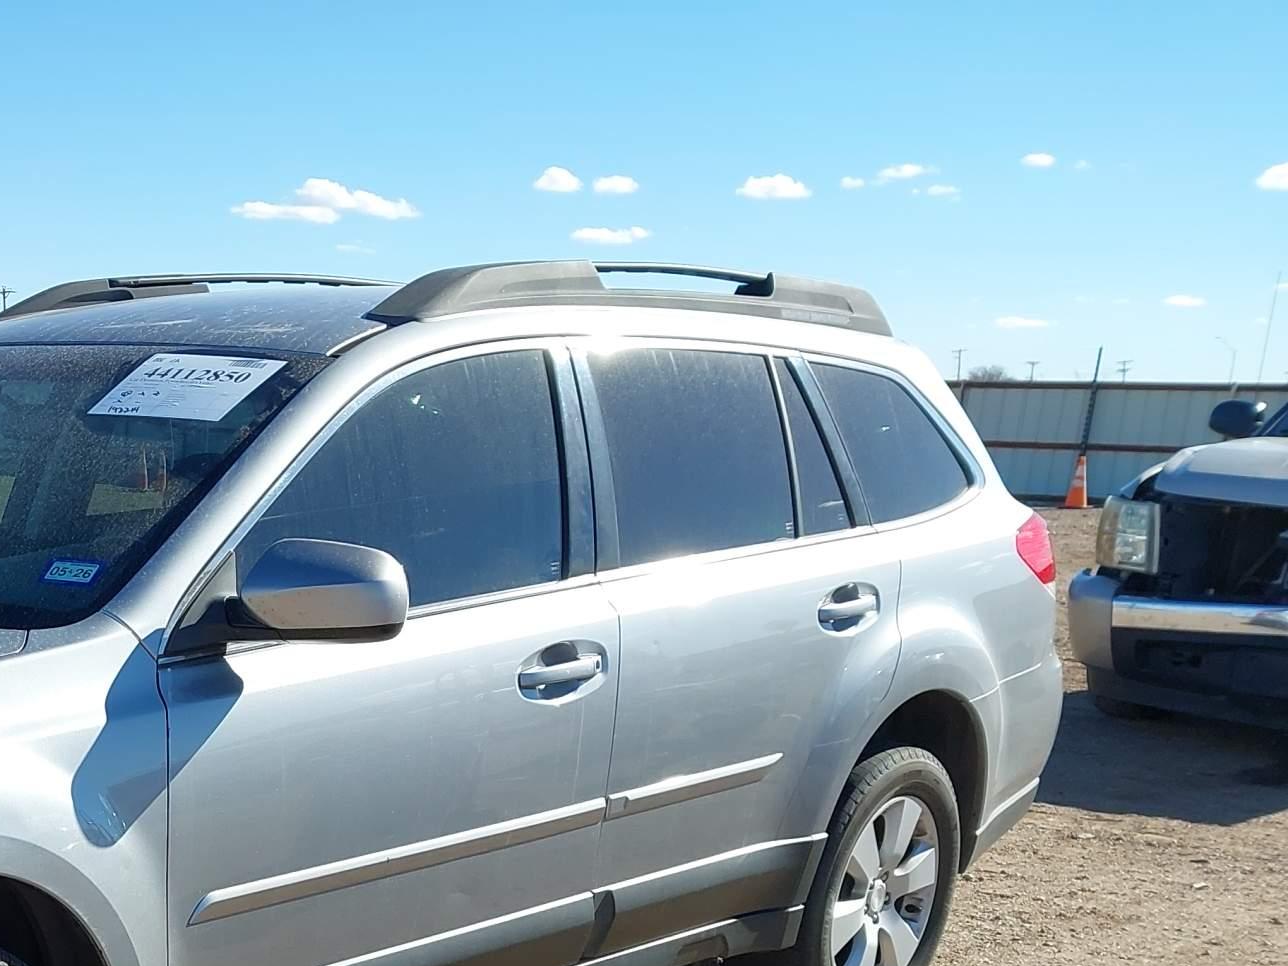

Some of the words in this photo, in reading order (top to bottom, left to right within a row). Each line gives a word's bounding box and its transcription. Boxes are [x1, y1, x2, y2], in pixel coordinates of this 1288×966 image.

[143, 366, 252, 384] 44112850
[49, 566, 69, 576] 05
[74, 568, 93, 579] 26
